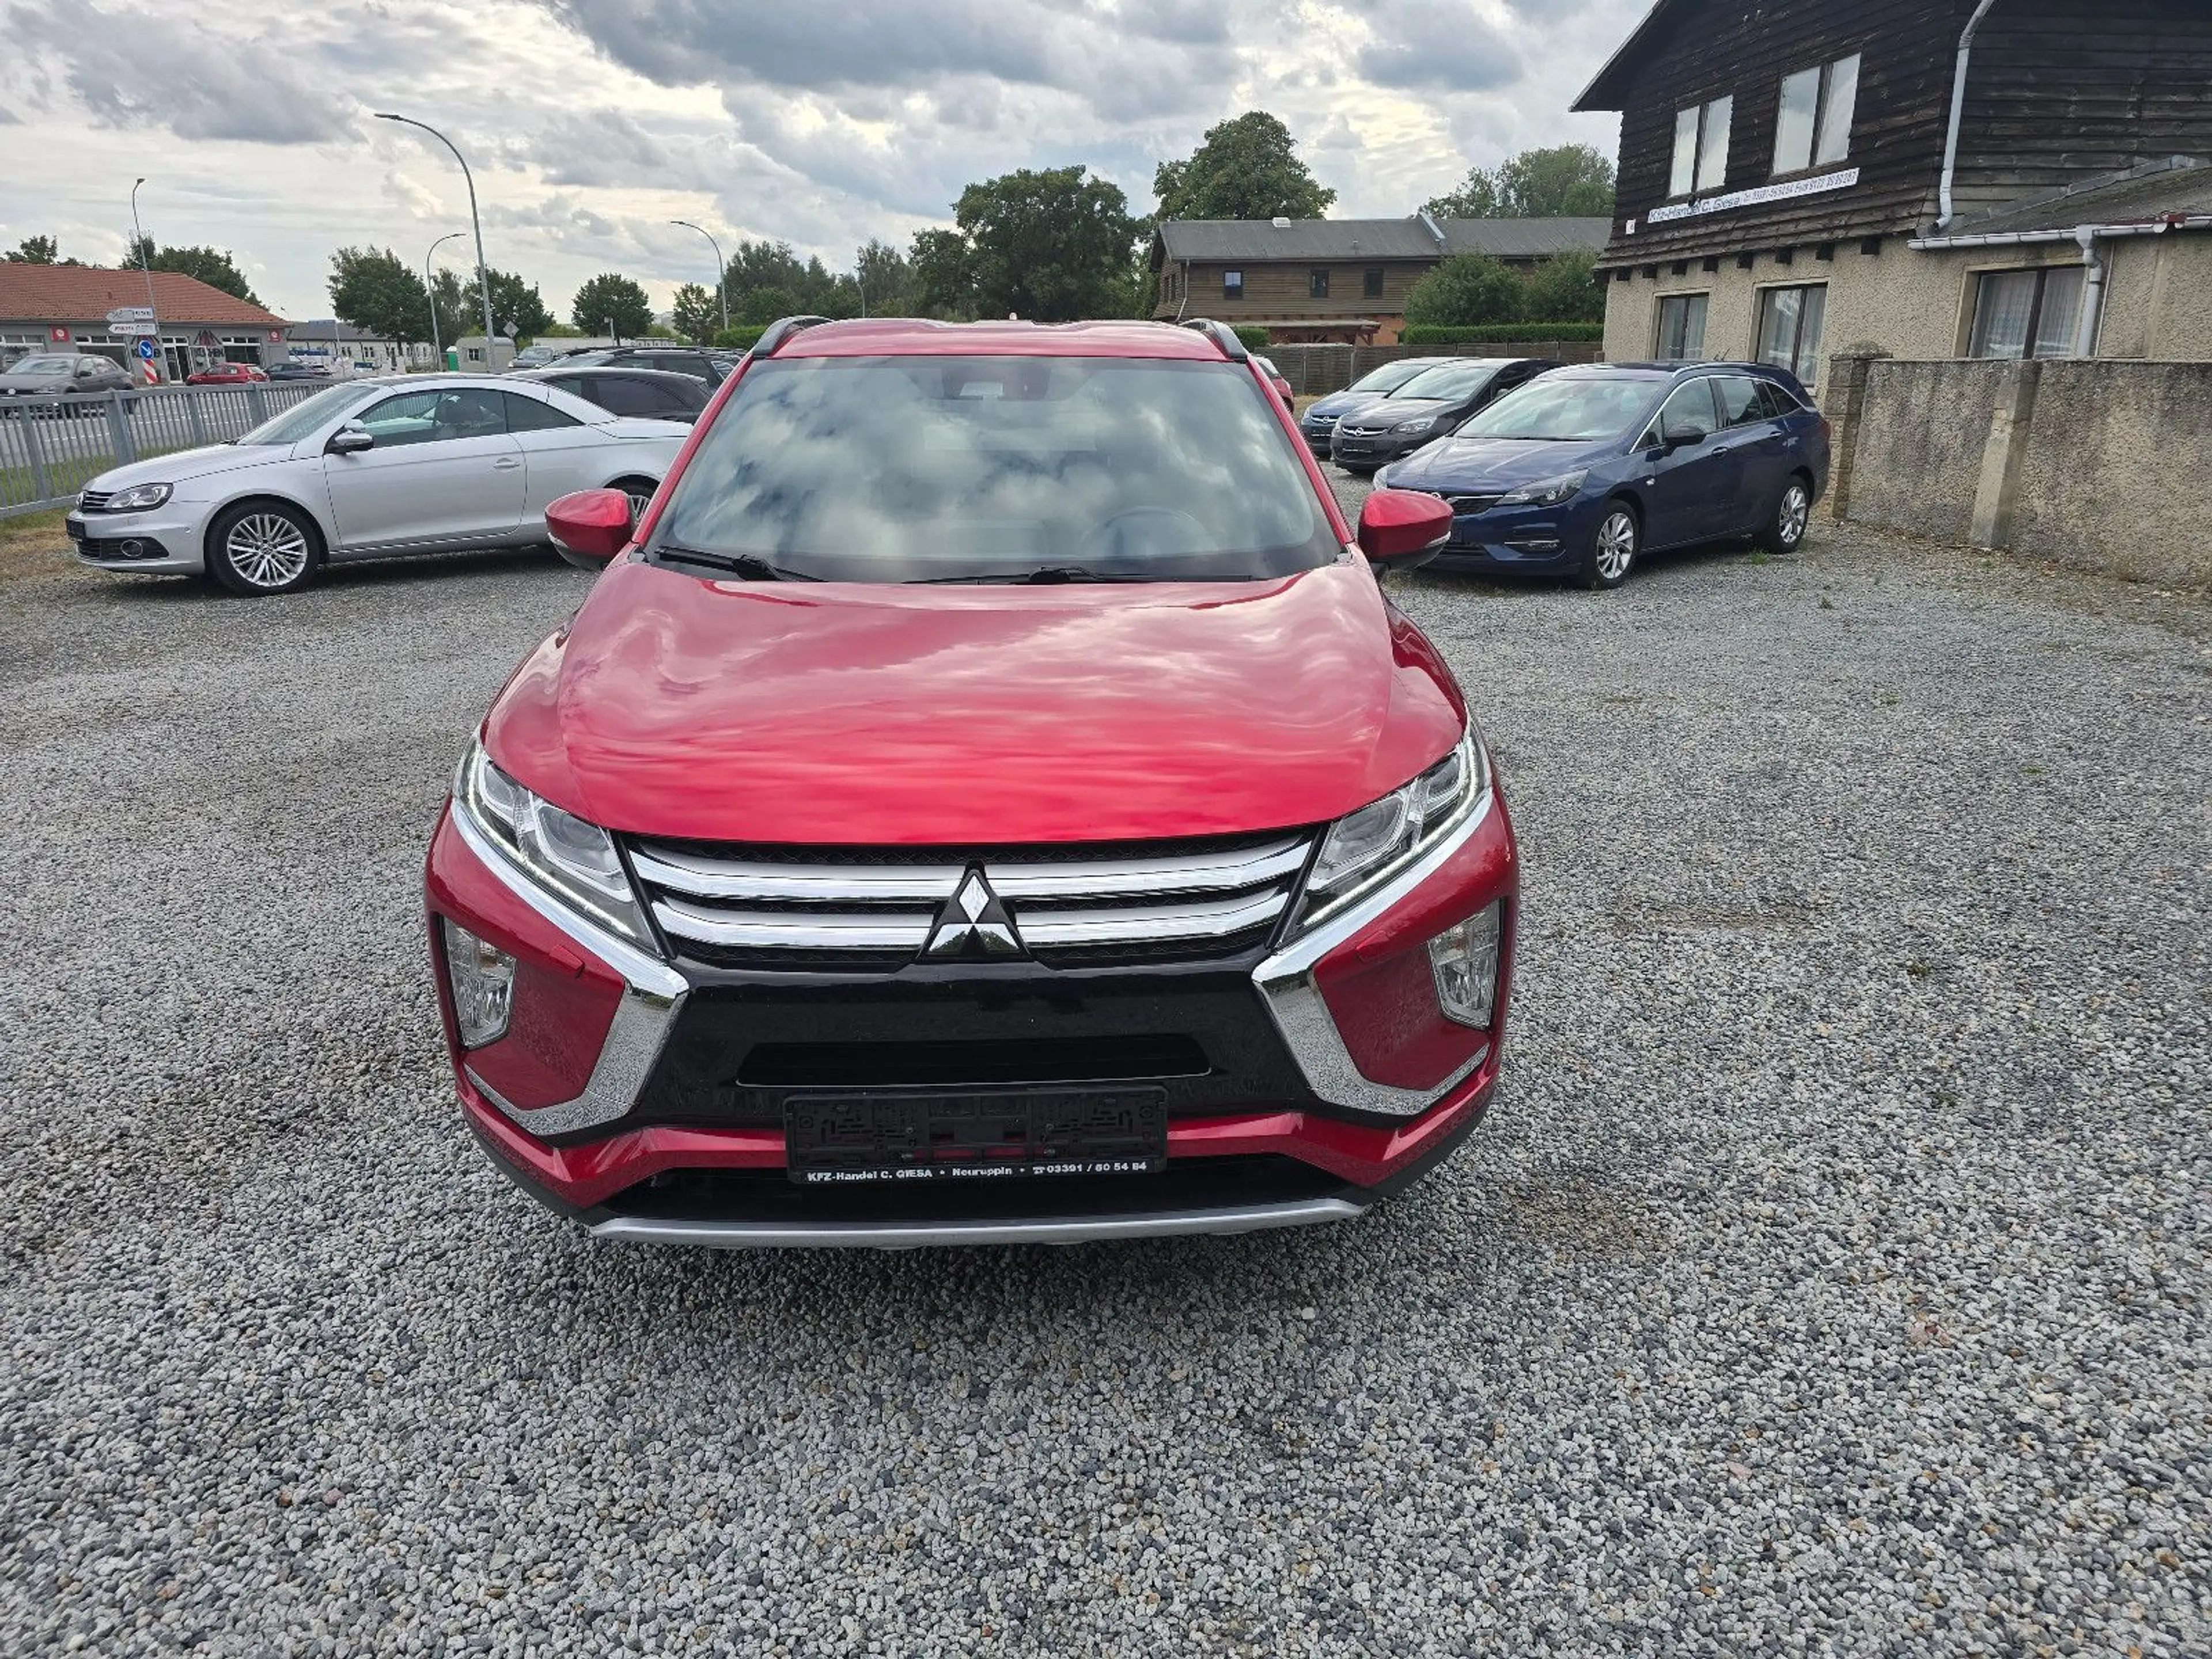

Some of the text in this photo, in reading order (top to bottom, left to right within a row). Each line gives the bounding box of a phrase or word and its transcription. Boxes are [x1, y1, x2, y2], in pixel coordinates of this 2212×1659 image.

[807, 1171, 877, 1181] KFZ-Handel
[880, 1170, 892, 1179] C.
[896, 1169, 933, 1178] GIESA
[952, 1166, 1013, 1176] Neuruppin
